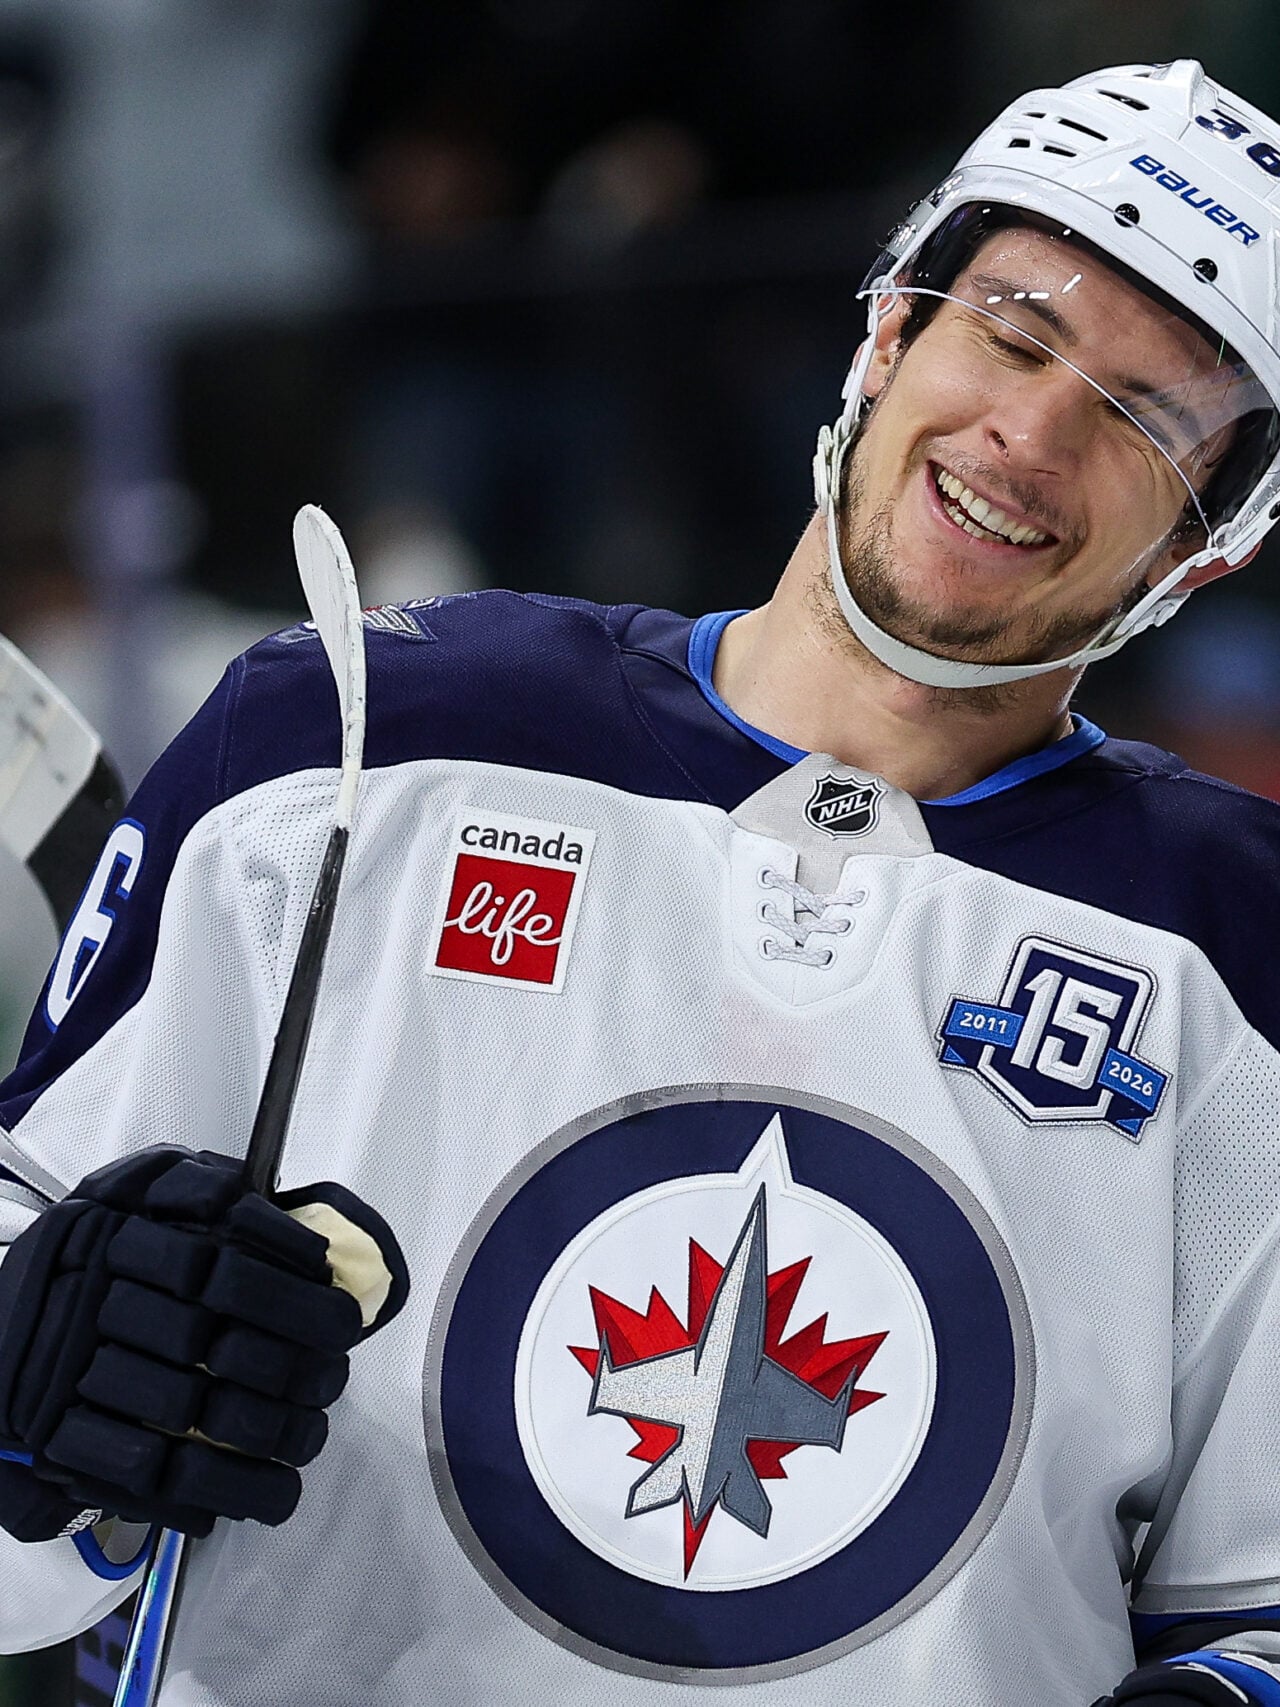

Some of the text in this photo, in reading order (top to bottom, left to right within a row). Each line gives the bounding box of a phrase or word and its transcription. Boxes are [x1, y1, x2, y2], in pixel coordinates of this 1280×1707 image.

[1129, 154, 1261, 246] BAUER
[818, 793, 868, 822] NHL
[460, 824, 583, 865] canada
[444, 881, 562, 966] life
[959, 1011, 1009, 1035] 2011
[1010, 968, 1124, 1090] 15
[1107, 1060, 1154, 1097] 2026
